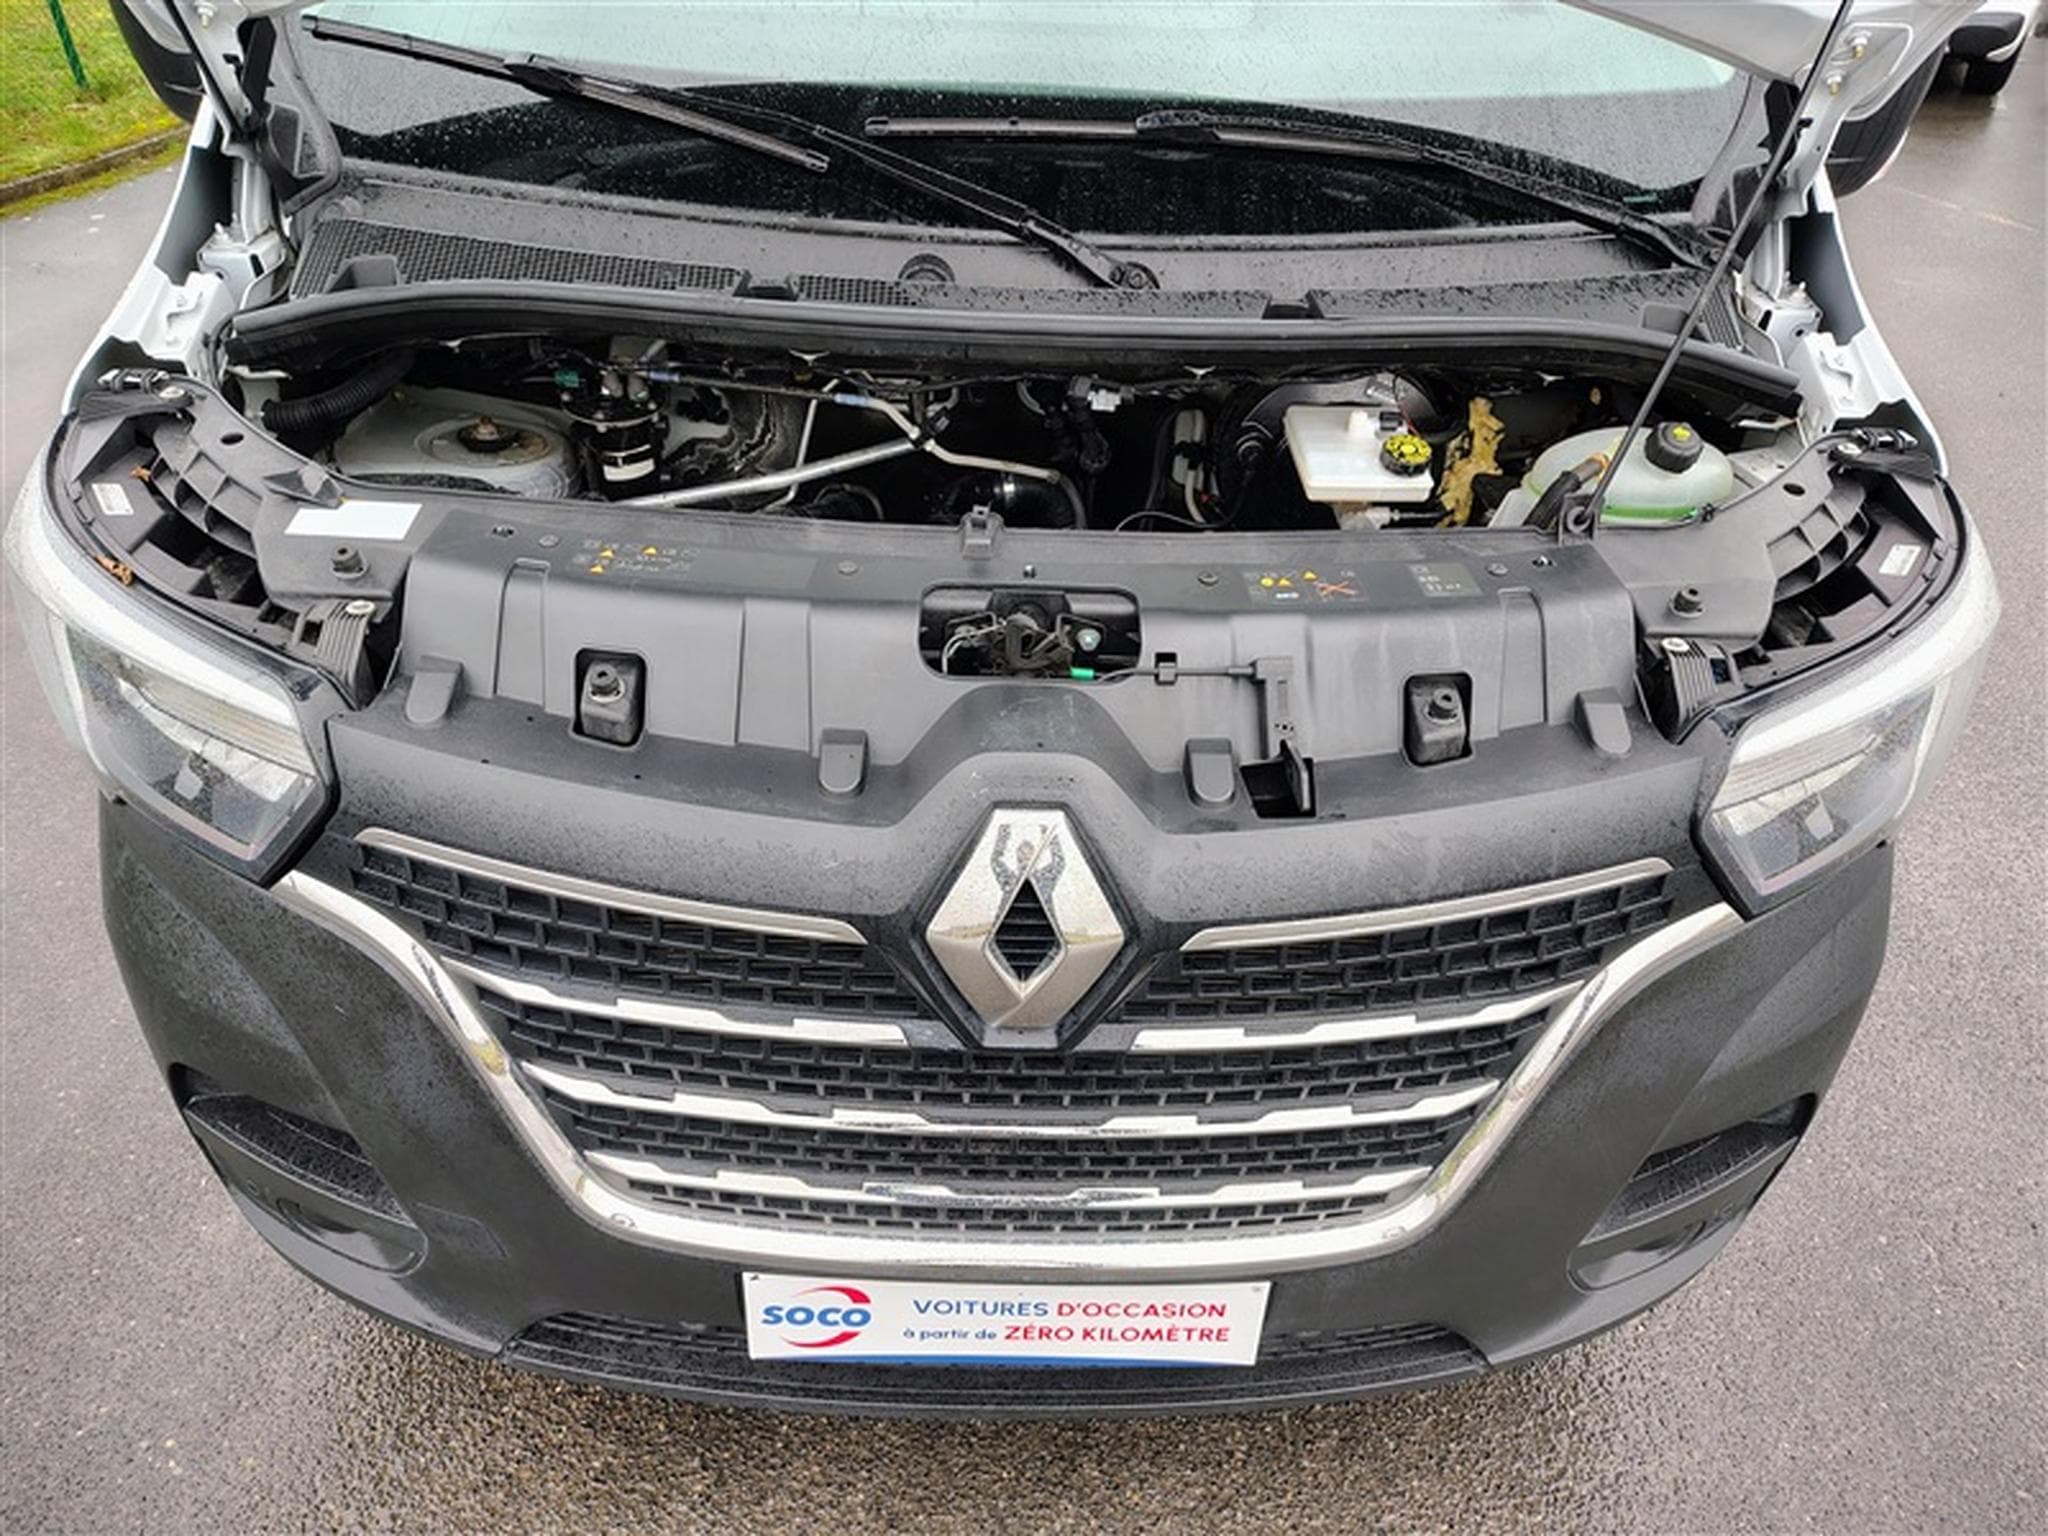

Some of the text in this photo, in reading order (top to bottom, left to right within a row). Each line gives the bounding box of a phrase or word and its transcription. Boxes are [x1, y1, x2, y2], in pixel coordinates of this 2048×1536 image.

[762, 1305, 872, 1328] SOCO
[912, 1299, 1227, 1319] VOITURES D'OCCASION
[903, 1323, 1231, 1343] à partir de ZÉRO KILOMÈTRE
